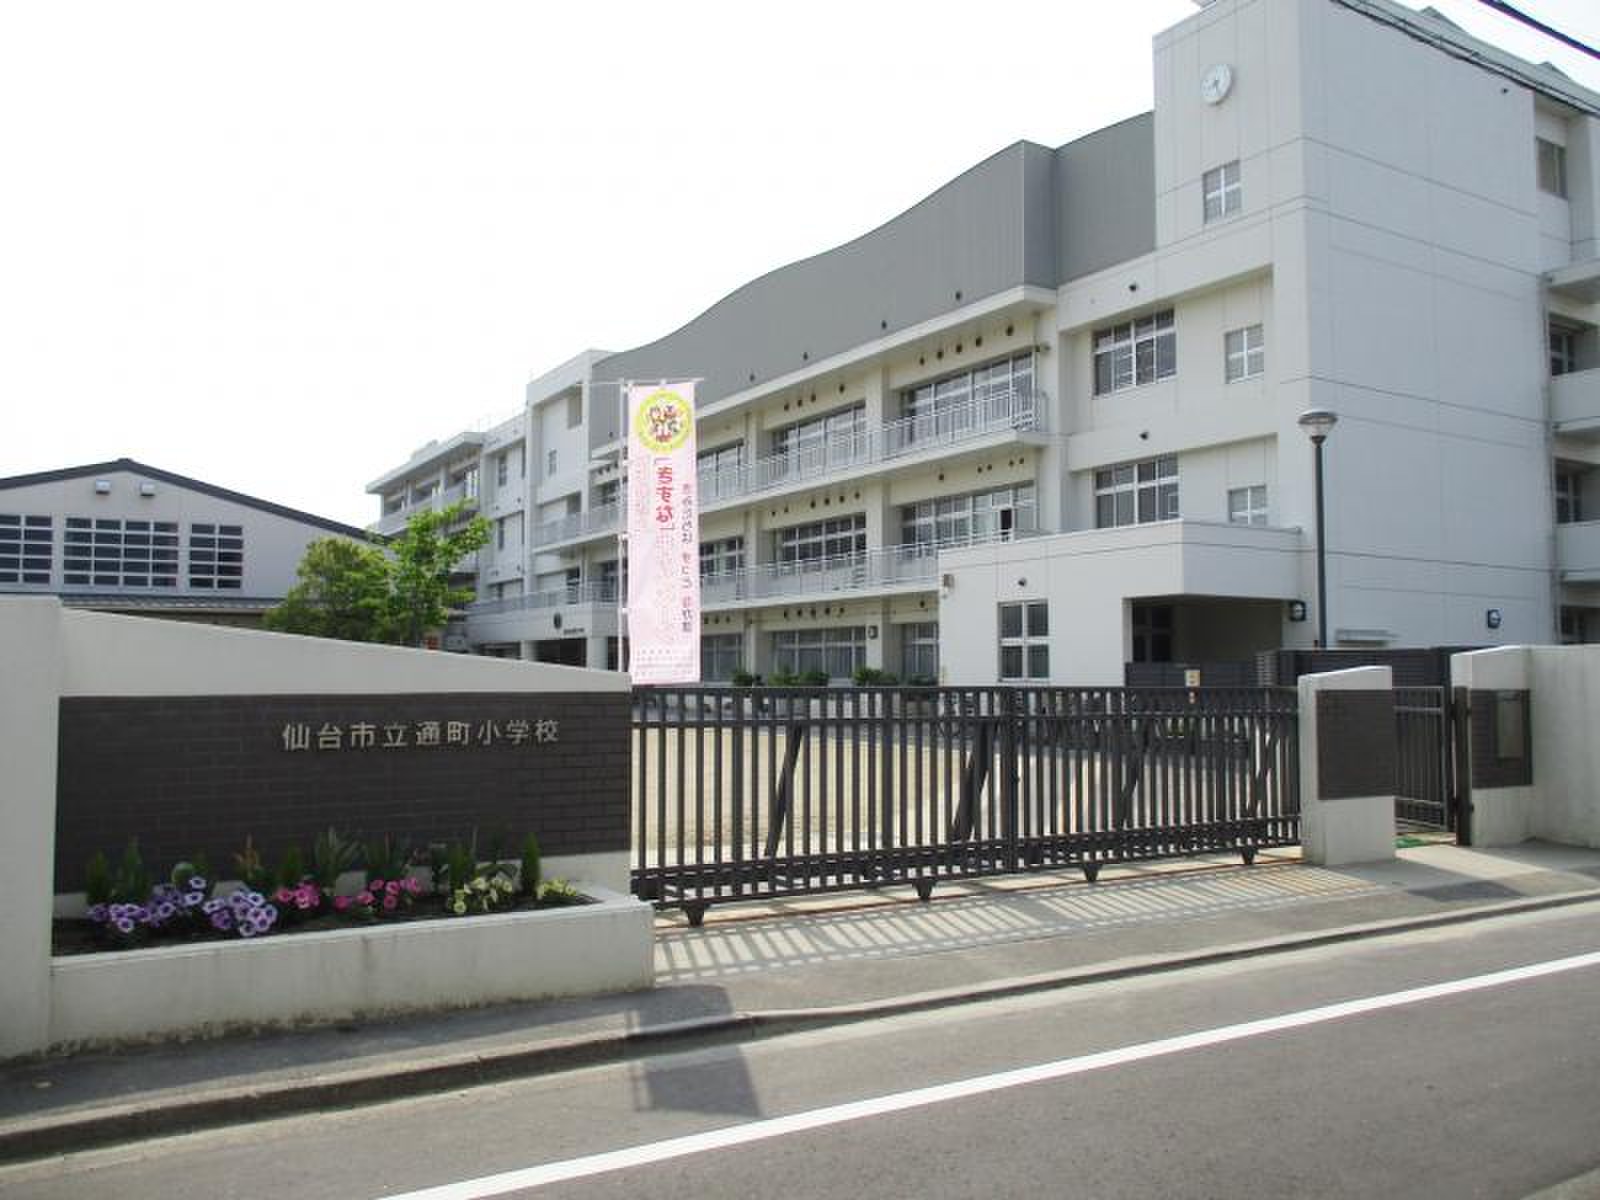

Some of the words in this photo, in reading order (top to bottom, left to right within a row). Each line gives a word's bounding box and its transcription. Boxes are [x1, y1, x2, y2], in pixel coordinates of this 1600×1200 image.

[281, 719, 560, 750] 仙台市立通町小学校
